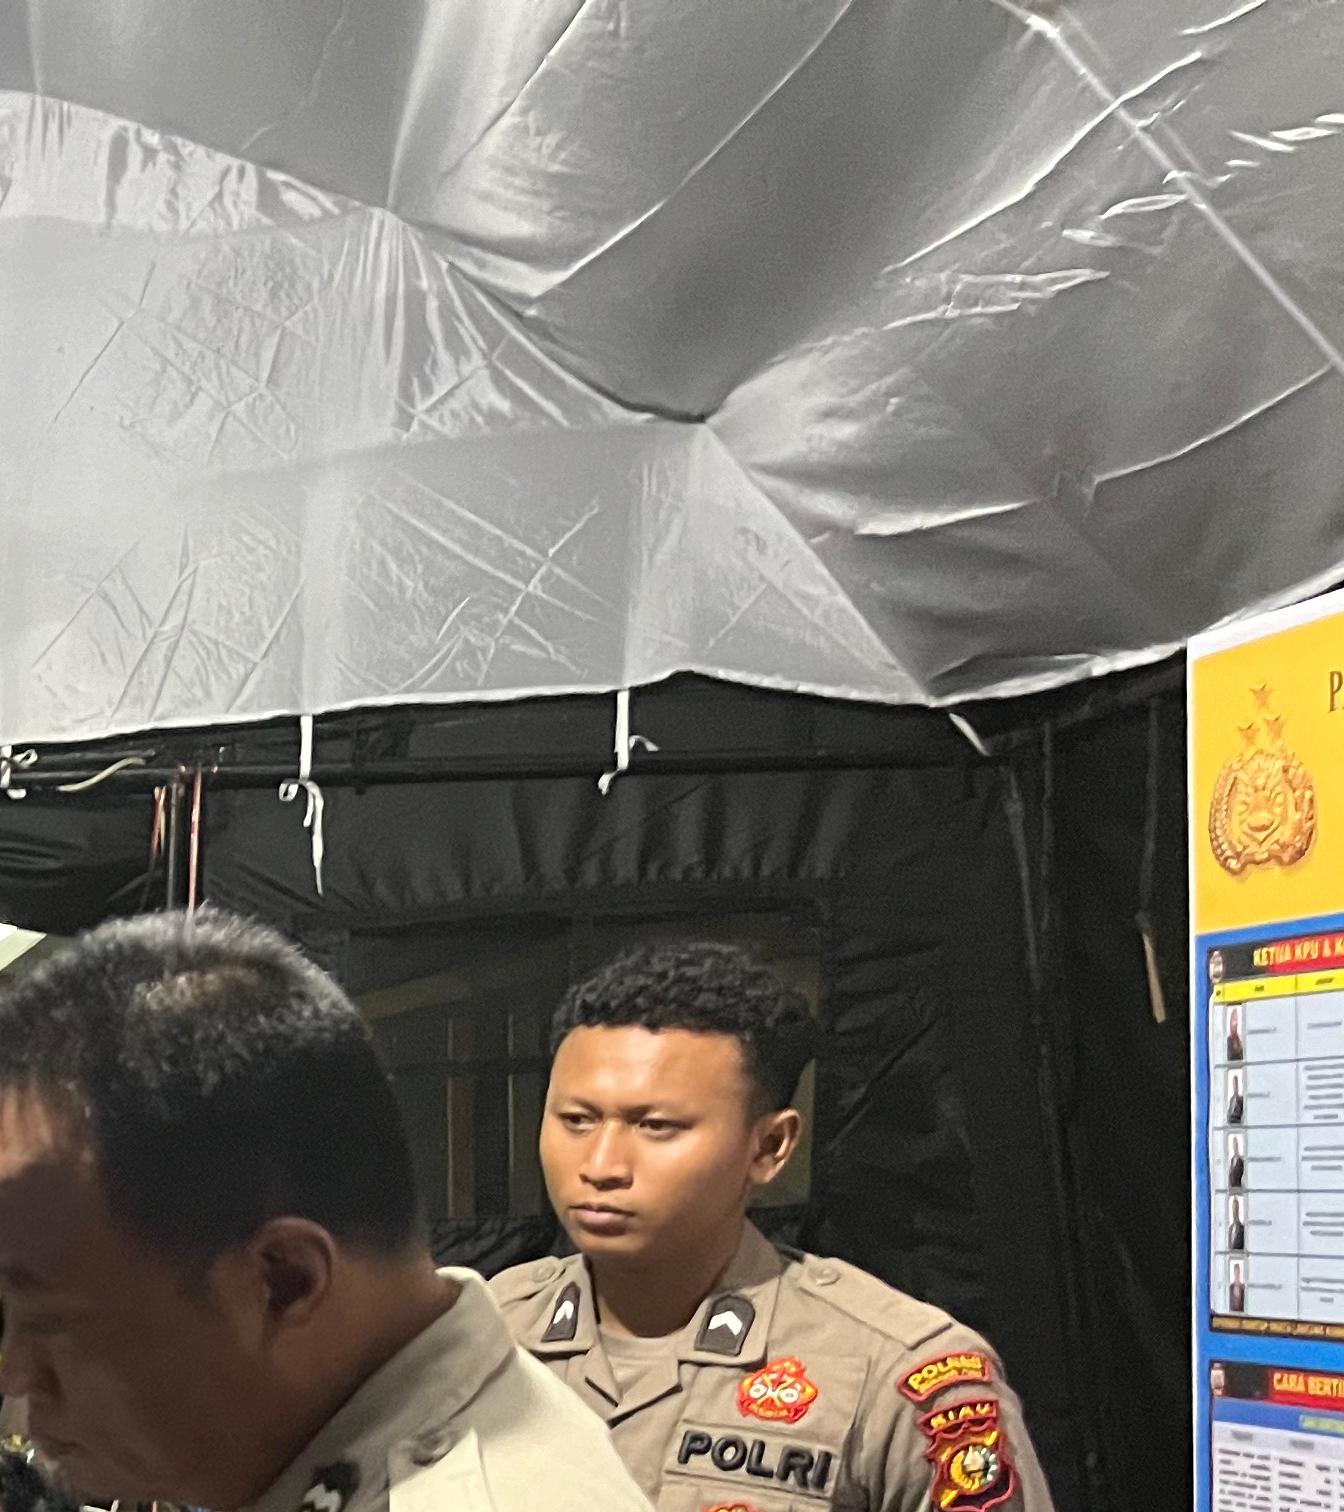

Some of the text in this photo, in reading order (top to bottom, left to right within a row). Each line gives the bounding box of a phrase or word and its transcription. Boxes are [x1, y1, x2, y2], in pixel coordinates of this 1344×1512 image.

[1329, 670, 1344, 711] P
[1273, 1372, 1305, 1393] CARA
[677, 1430, 833, 1490] POLRI
